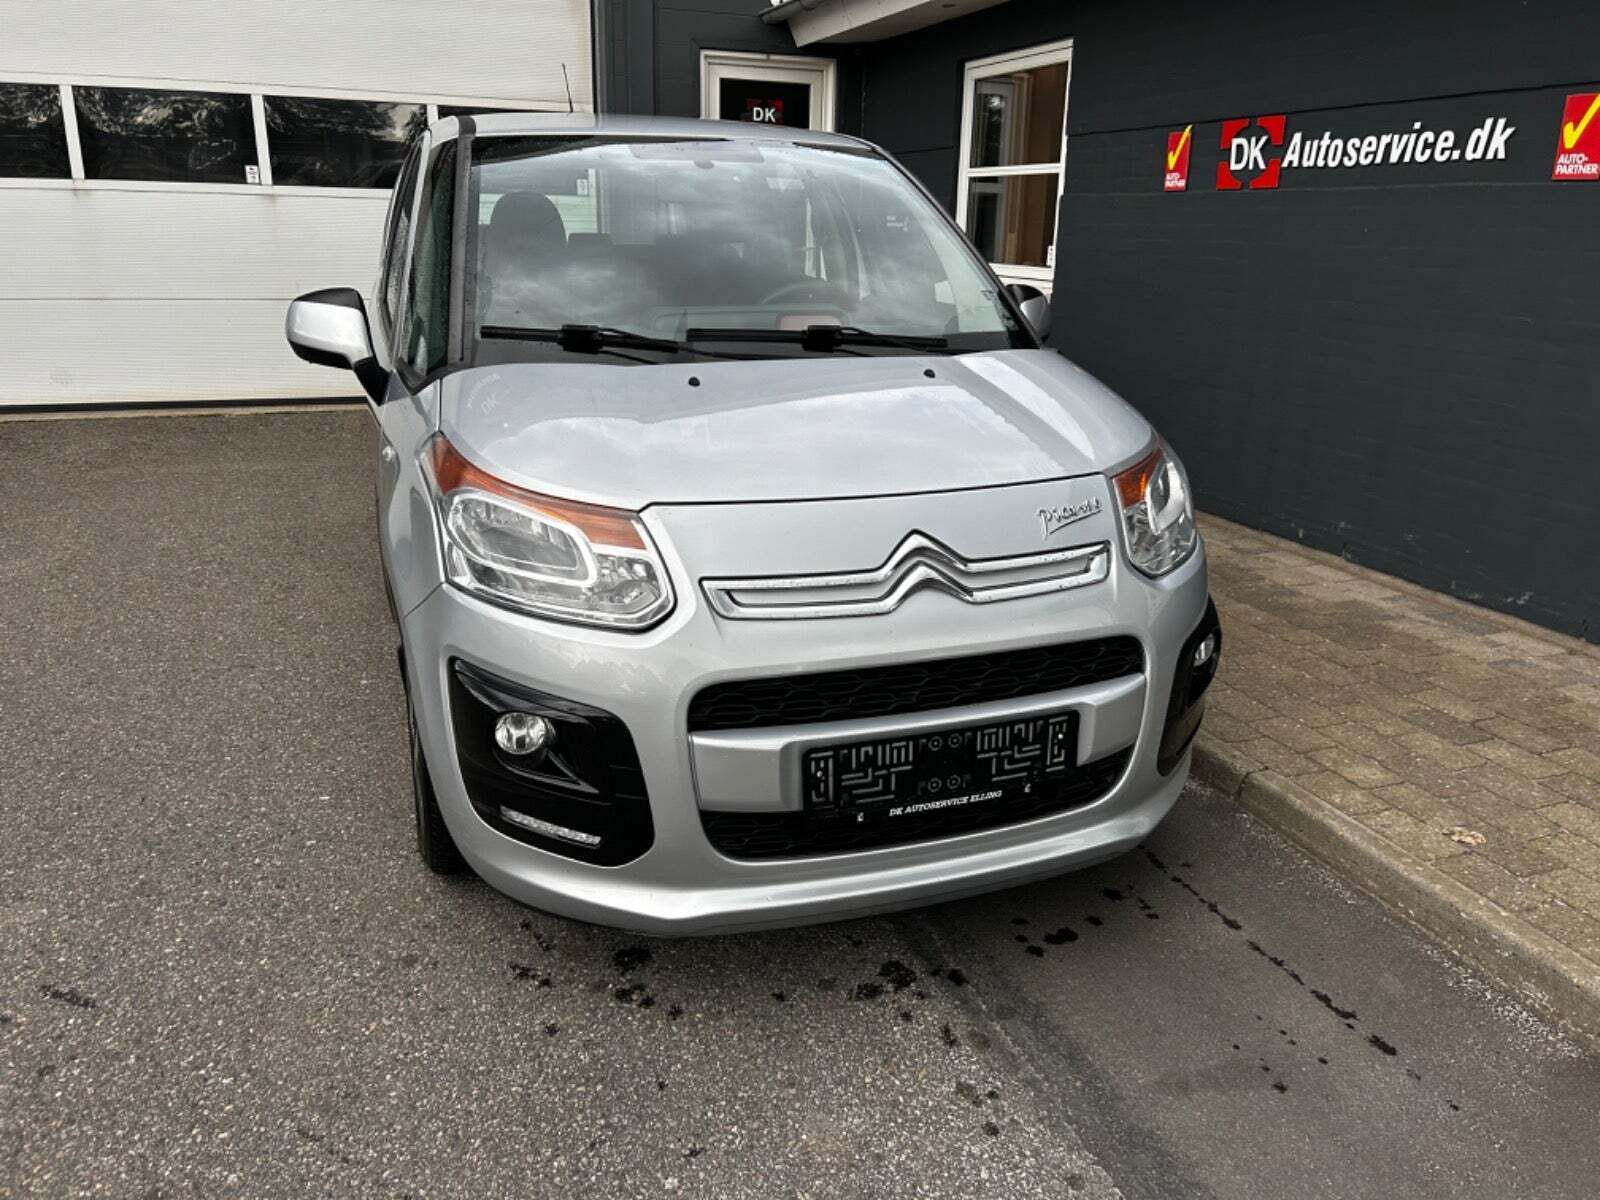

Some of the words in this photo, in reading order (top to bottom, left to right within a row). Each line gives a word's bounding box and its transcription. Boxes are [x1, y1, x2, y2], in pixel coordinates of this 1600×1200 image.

[753, 107, 776, 122] DK
[1229, 135, 1269, 170] DK
[1281, 117, 1517, 168] Autoservice.dk
[1555, 163, 1598, 175] PARTNER
[889, 807, 904, 816] DK
[904, 796, 969, 814] AUTOSERVICE
[969, 790, 1003, 803] ELLING
